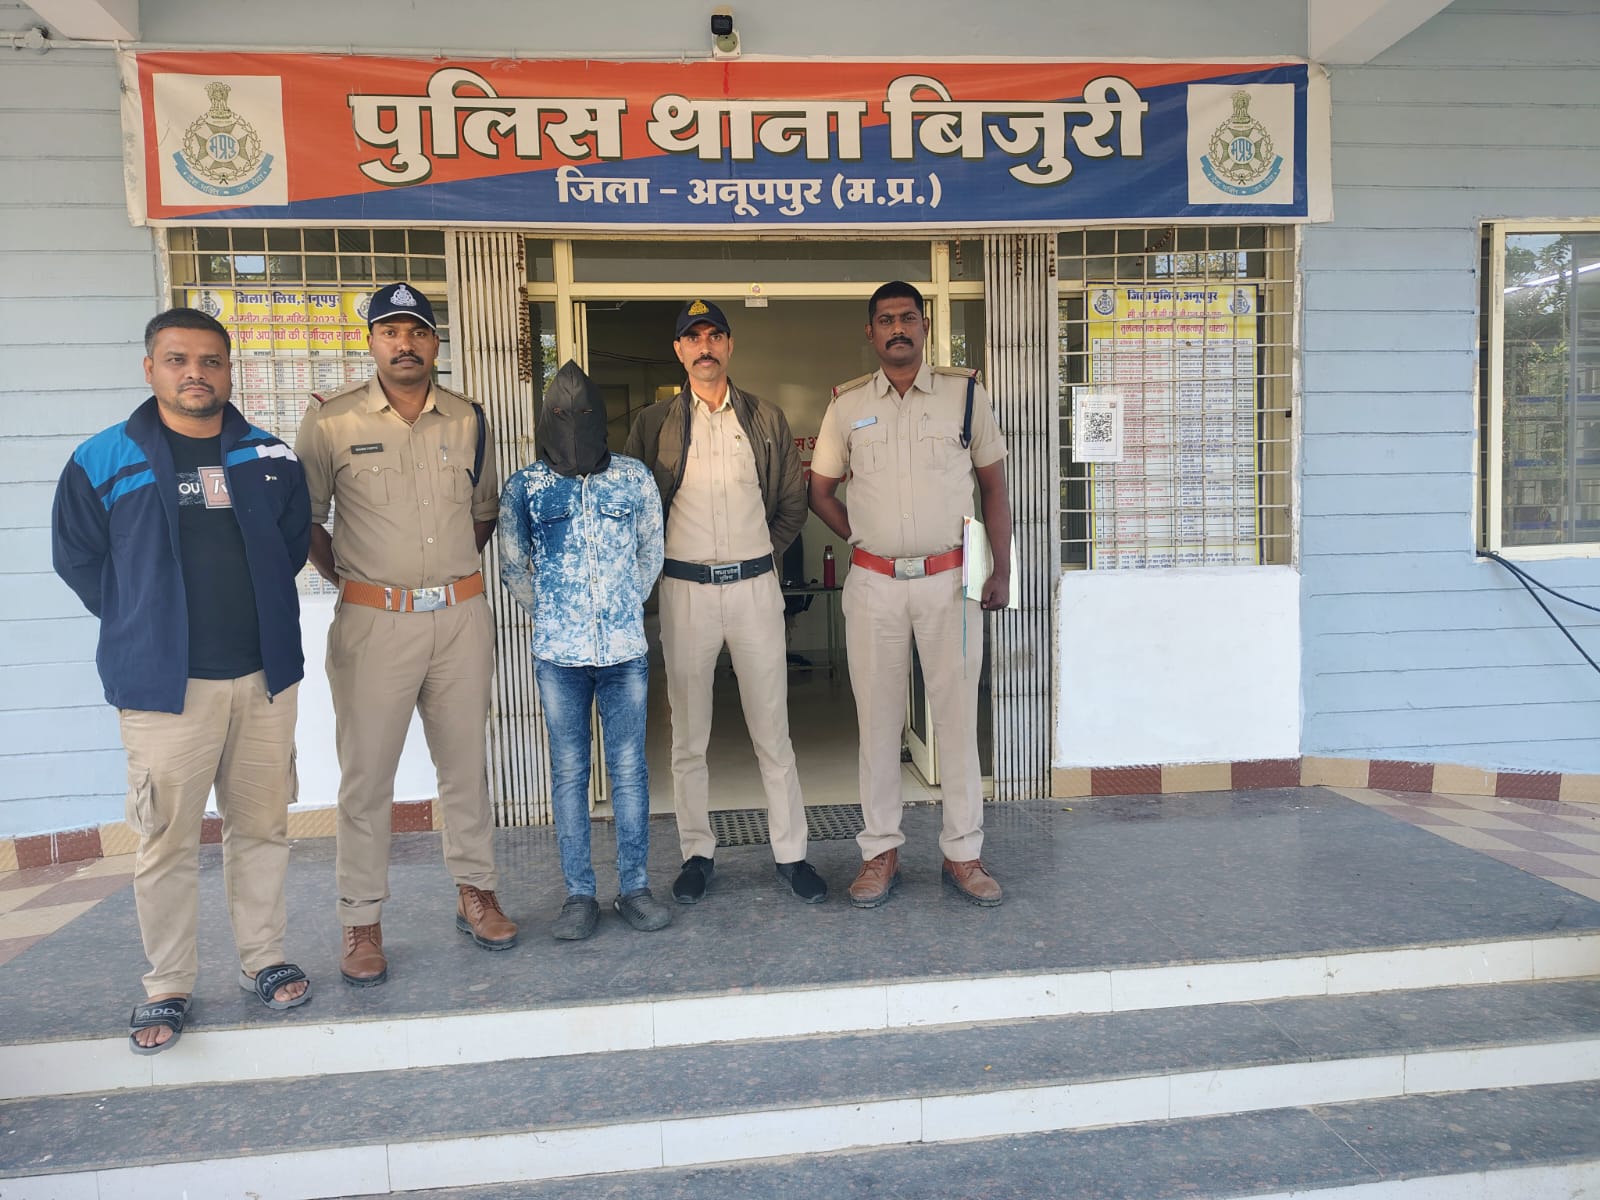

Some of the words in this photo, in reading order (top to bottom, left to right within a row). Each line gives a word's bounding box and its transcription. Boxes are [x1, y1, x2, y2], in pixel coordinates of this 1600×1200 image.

[347, 67, 628, 187] पुलिस
[646, 93, 868, 162] थाना
[882, 75, 1149, 187] बिजुरी
[555, 165, 650, 204] जिला
[687, 178, 822, 216] अनूपपुर
[831, 172, 942, 209] (म.प्र.)
